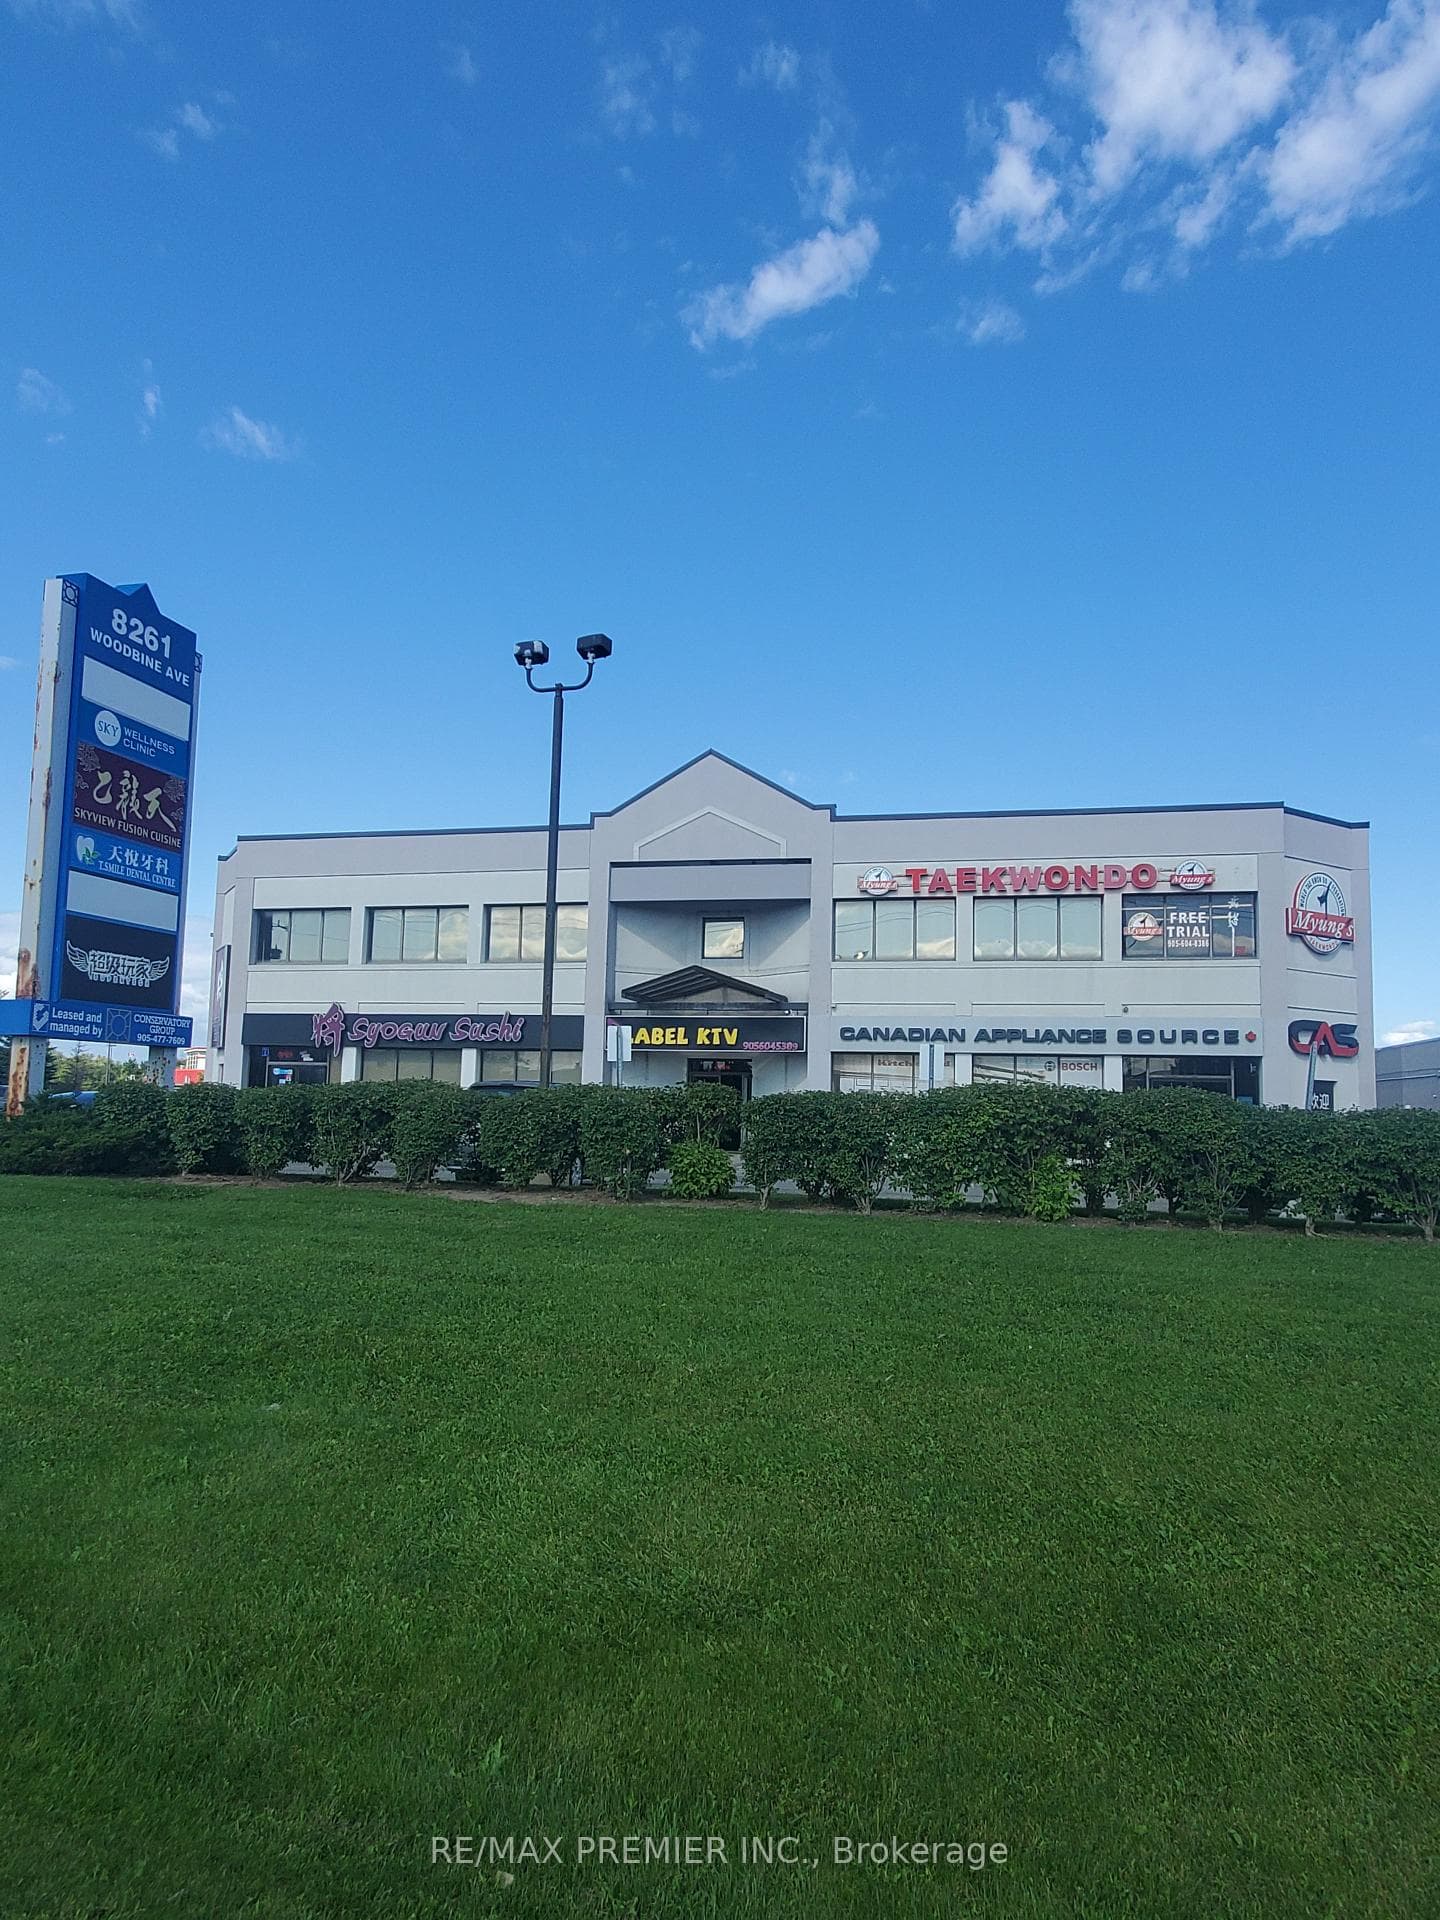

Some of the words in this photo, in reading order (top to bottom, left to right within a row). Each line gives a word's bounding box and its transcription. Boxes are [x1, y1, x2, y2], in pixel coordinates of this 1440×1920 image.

[111, 608, 171, 659] 8261
[90, 627, 162, 674] WOODBINE
[165, 669, 190, 687] AVE
[97, 721, 119, 738] SKY
[123, 726, 176, 755] WELLNESS
[123, 738, 156, 757] CLINIC
[74, 807, 117, 829] SKYVIEW
[117, 820, 149, 839] FUSION
[150, 830, 182, 848] CUISINE
[126, 867, 151, 881] DENTAL
[151, 873, 176, 888] CENTRE
[905, 864, 1158, 893] TAEKWONDO
[1170, 911, 1207, 924] FREE
[1167, 925, 1209, 938] TRIAL
[52, 1009, 84, 1021] Leased
[86, 1013, 102, 1023] and
[133, 1014, 192, 1028] CONSERVATORY
[50, 1023, 90, 1037] managed
[92, 1026, 103, 1037] by
[149, 1025, 176, 1035] GROUP
[449, 1010, 526, 1042] Sushi
[136, 1033, 186, 1045] 905-477-7609
[631, 1027, 689, 1046] ABEL
[696, 1027, 739, 1046] KTV
[840, 1027, 966, 1042] CANADIAN
[974, 1028, 1107, 1044] APPLIANCE
[1117, 1029, 1239, 1044] SOURCE
[1061, 1062, 1098, 1072] BOSCH
